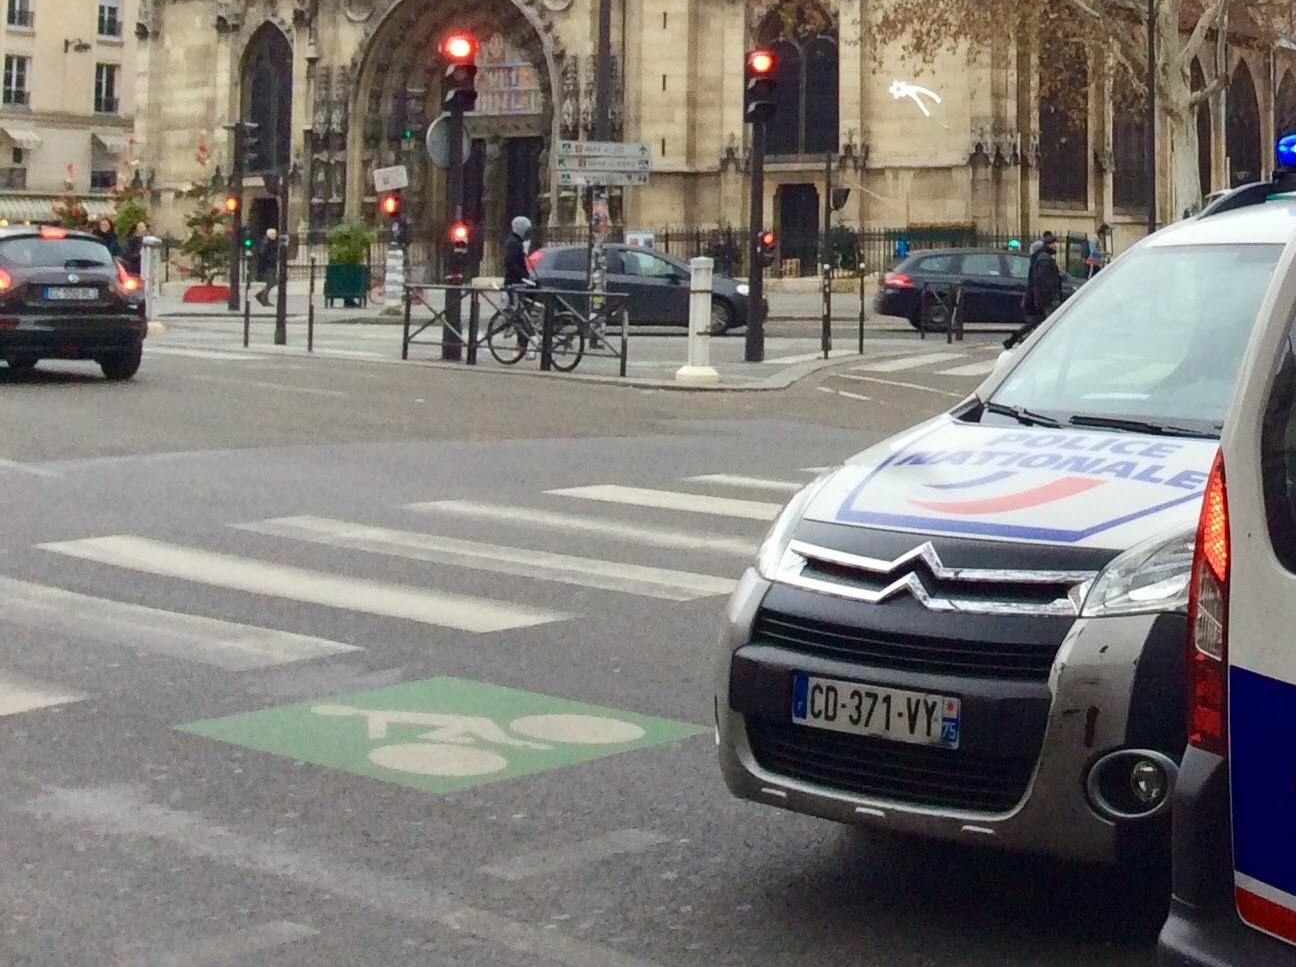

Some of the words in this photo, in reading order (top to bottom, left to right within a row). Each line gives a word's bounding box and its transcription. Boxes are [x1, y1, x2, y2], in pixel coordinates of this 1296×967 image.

[987, 432, 1185, 459] POLICE
[893, 450, 1210, 491] NATIONALE
[810, 684, 937, 736] CD-371-VY
[942, 721, 956, 740] 75
